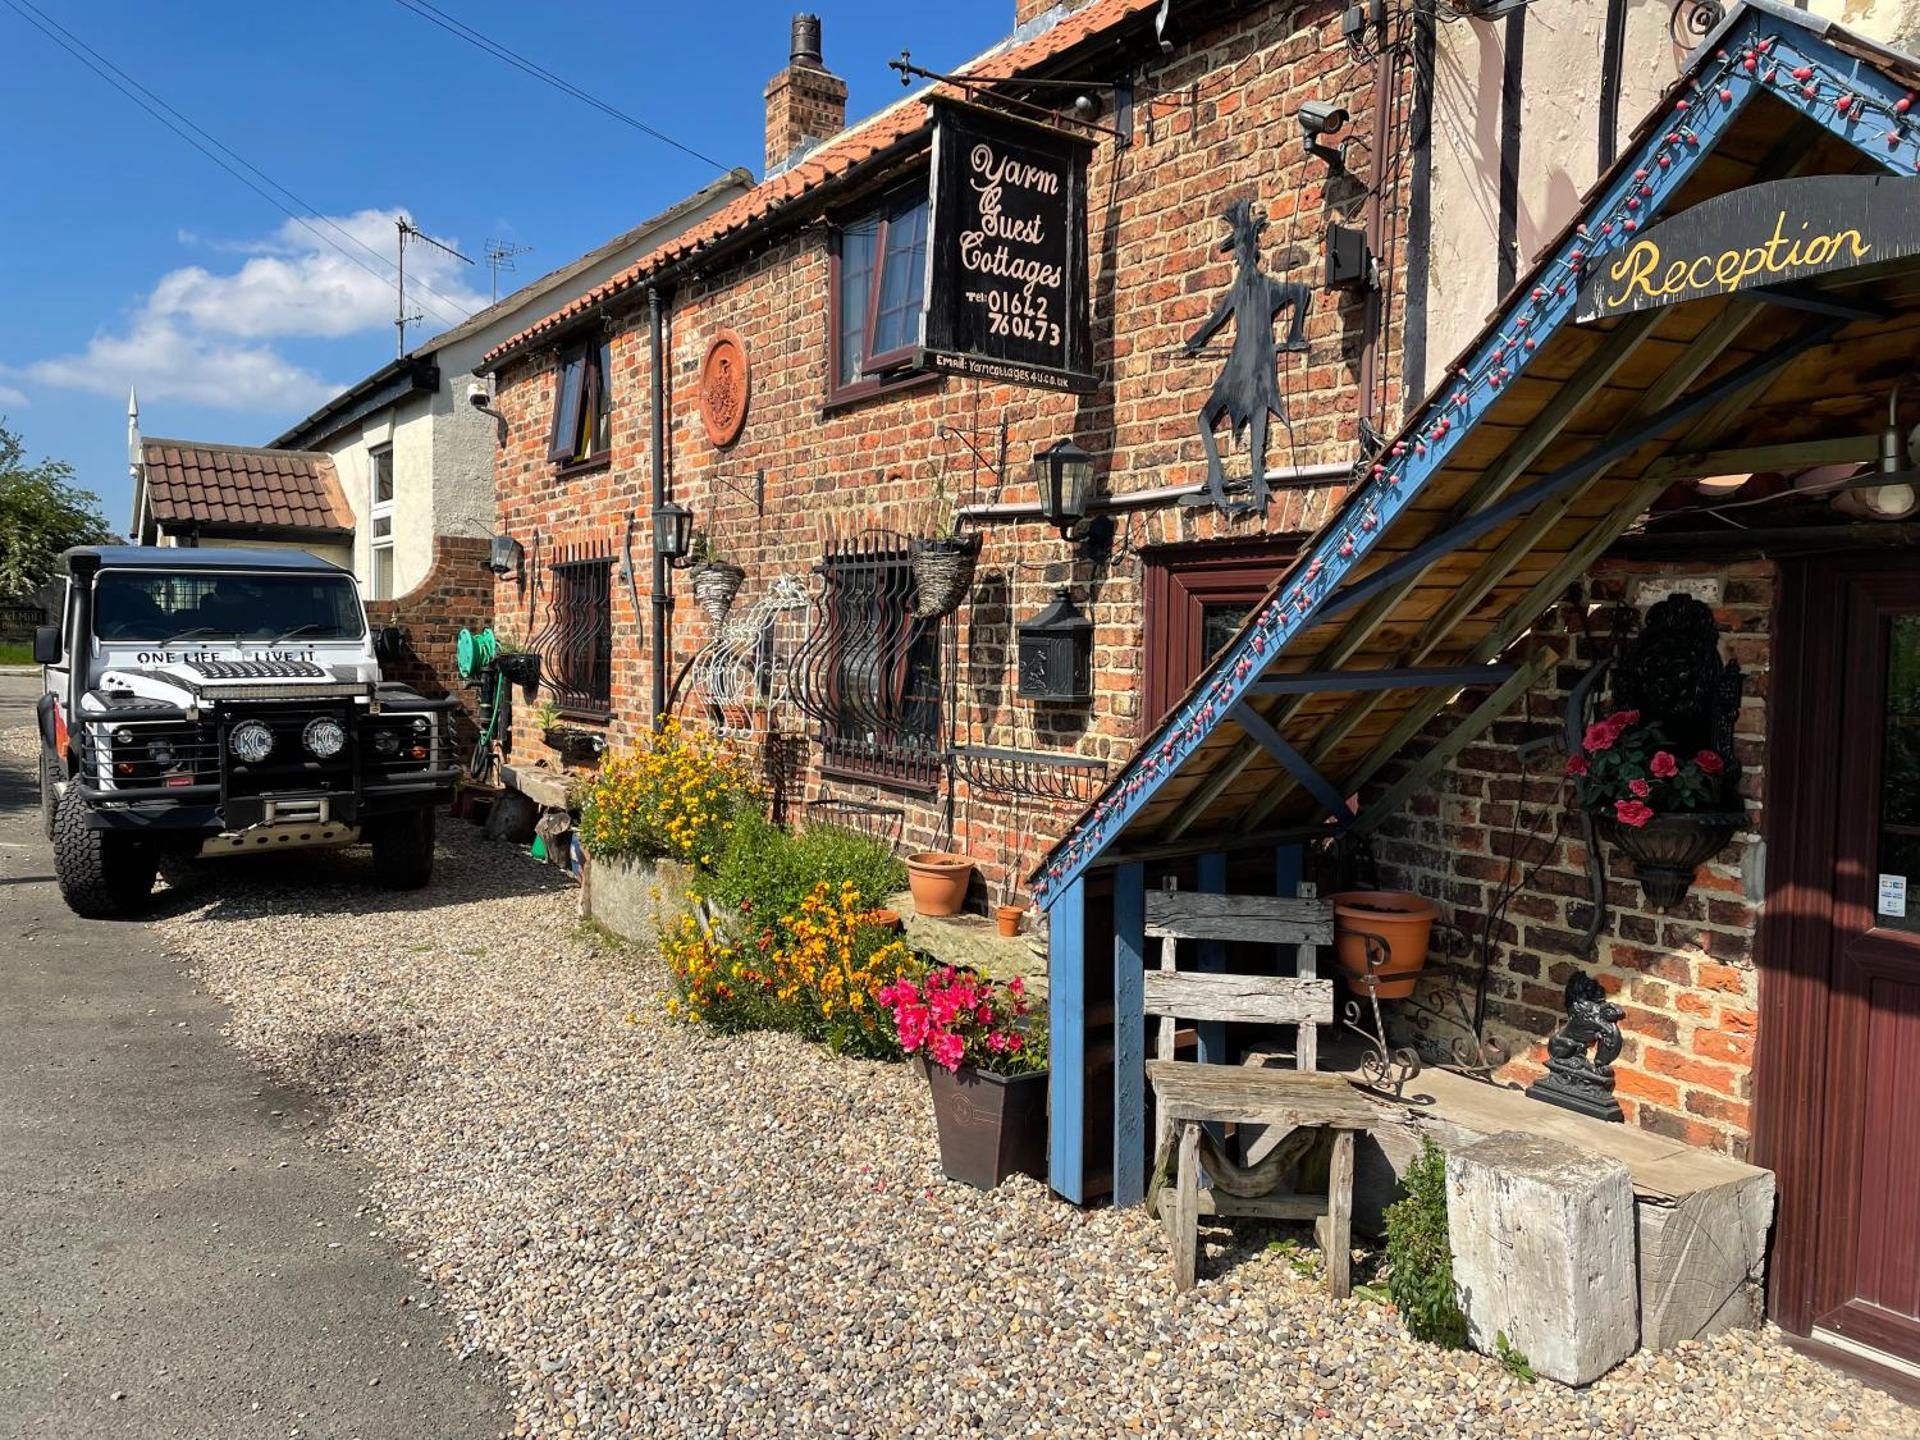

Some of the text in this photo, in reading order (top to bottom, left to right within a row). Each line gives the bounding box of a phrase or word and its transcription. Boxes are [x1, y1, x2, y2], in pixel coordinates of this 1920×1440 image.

[970, 143, 1059, 196] Yarm
[979, 186, 1045, 245] Guest
[960, 231, 1062, 297] Cottages
[1607, 210, 1871, 308] Reception
[988, 289, 1048, 319] 01642
[988, 311, 1061, 347] 760473
[137, 651, 316, 664] ONE LIFE LIVE IT
[240, 729, 268, 752] KC
[314, 726, 340, 750] KC
